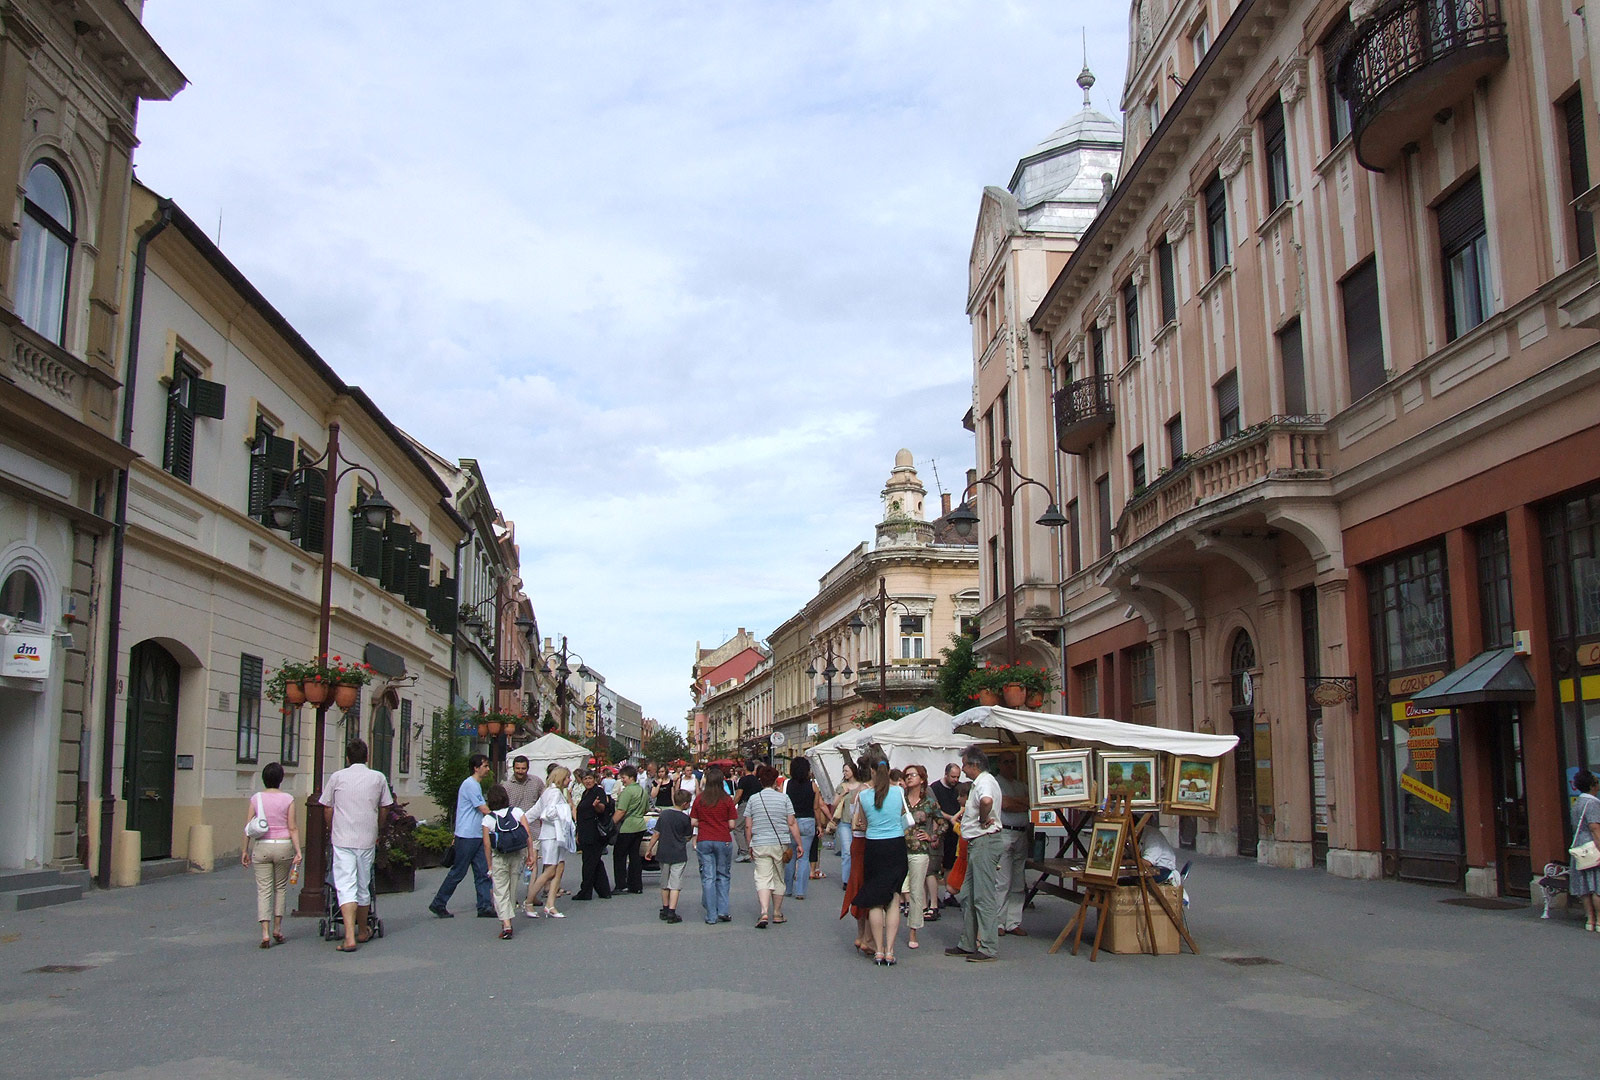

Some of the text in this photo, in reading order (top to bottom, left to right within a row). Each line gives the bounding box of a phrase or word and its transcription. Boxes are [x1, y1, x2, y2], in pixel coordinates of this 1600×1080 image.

[17, 642, 37, 655] dm
[1400, 674, 1435, 692] CORNER
[1412, 751, 1436, 759] EXCHANGE
